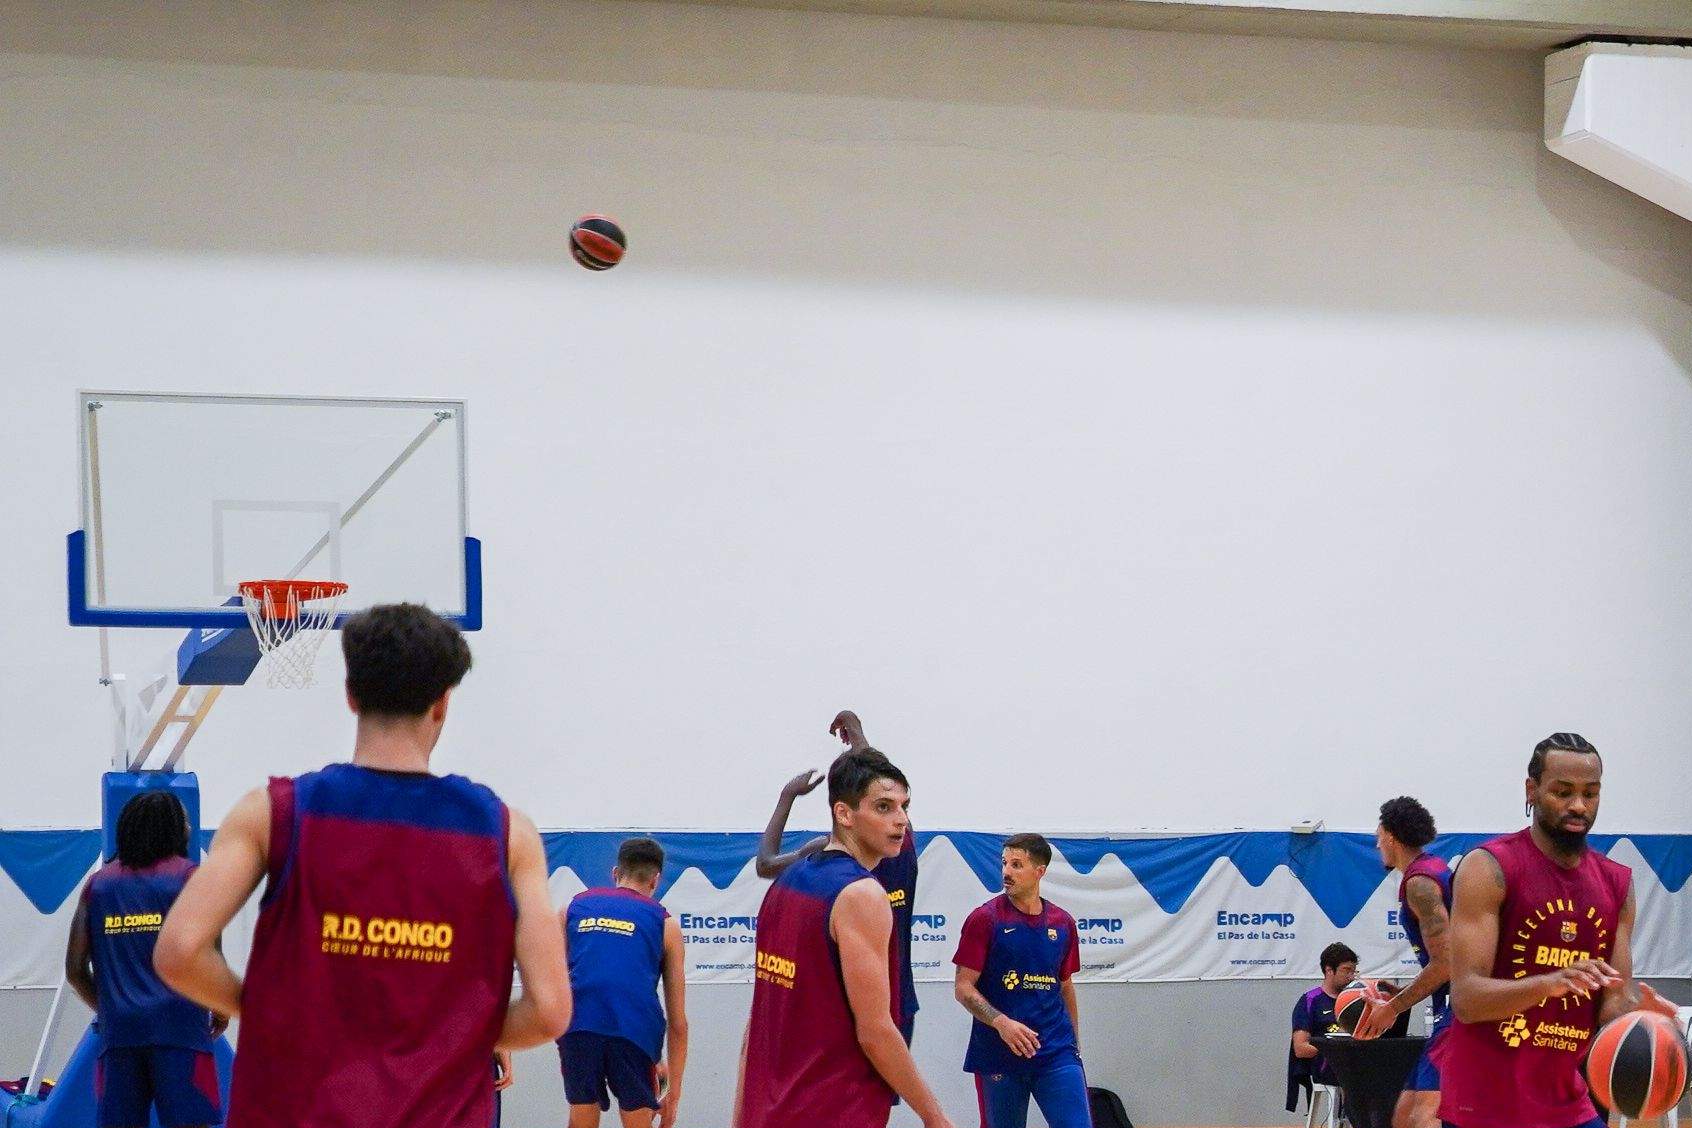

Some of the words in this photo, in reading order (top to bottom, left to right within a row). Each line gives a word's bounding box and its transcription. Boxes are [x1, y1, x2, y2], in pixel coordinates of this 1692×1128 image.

[124, 914, 162, 927] CONGO
[1077, 918, 1123, 932] amp
[1217, 910, 1295, 927] Encamp
[322, 914, 365, 941] R.D.
[367, 918, 453, 948] CONGO
[922, 933, 947, 942] Casa
[1217, 932, 1227, 940] El
[1228, 932, 1245, 940] Pas
[1247, 931, 1260, 940] de
[1262, 931, 1271, 940] la
[1272, 931, 1296, 940] Casa
[692, 936, 710, 944] Pas
[712, 936, 726, 944] de
[728, 935, 738, 944] la
[1100, 936, 1124, 945] Casa
[1512, 898, 1575, 979] BARCELONA
[1532, 1034, 1578, 1051] Sanitària
